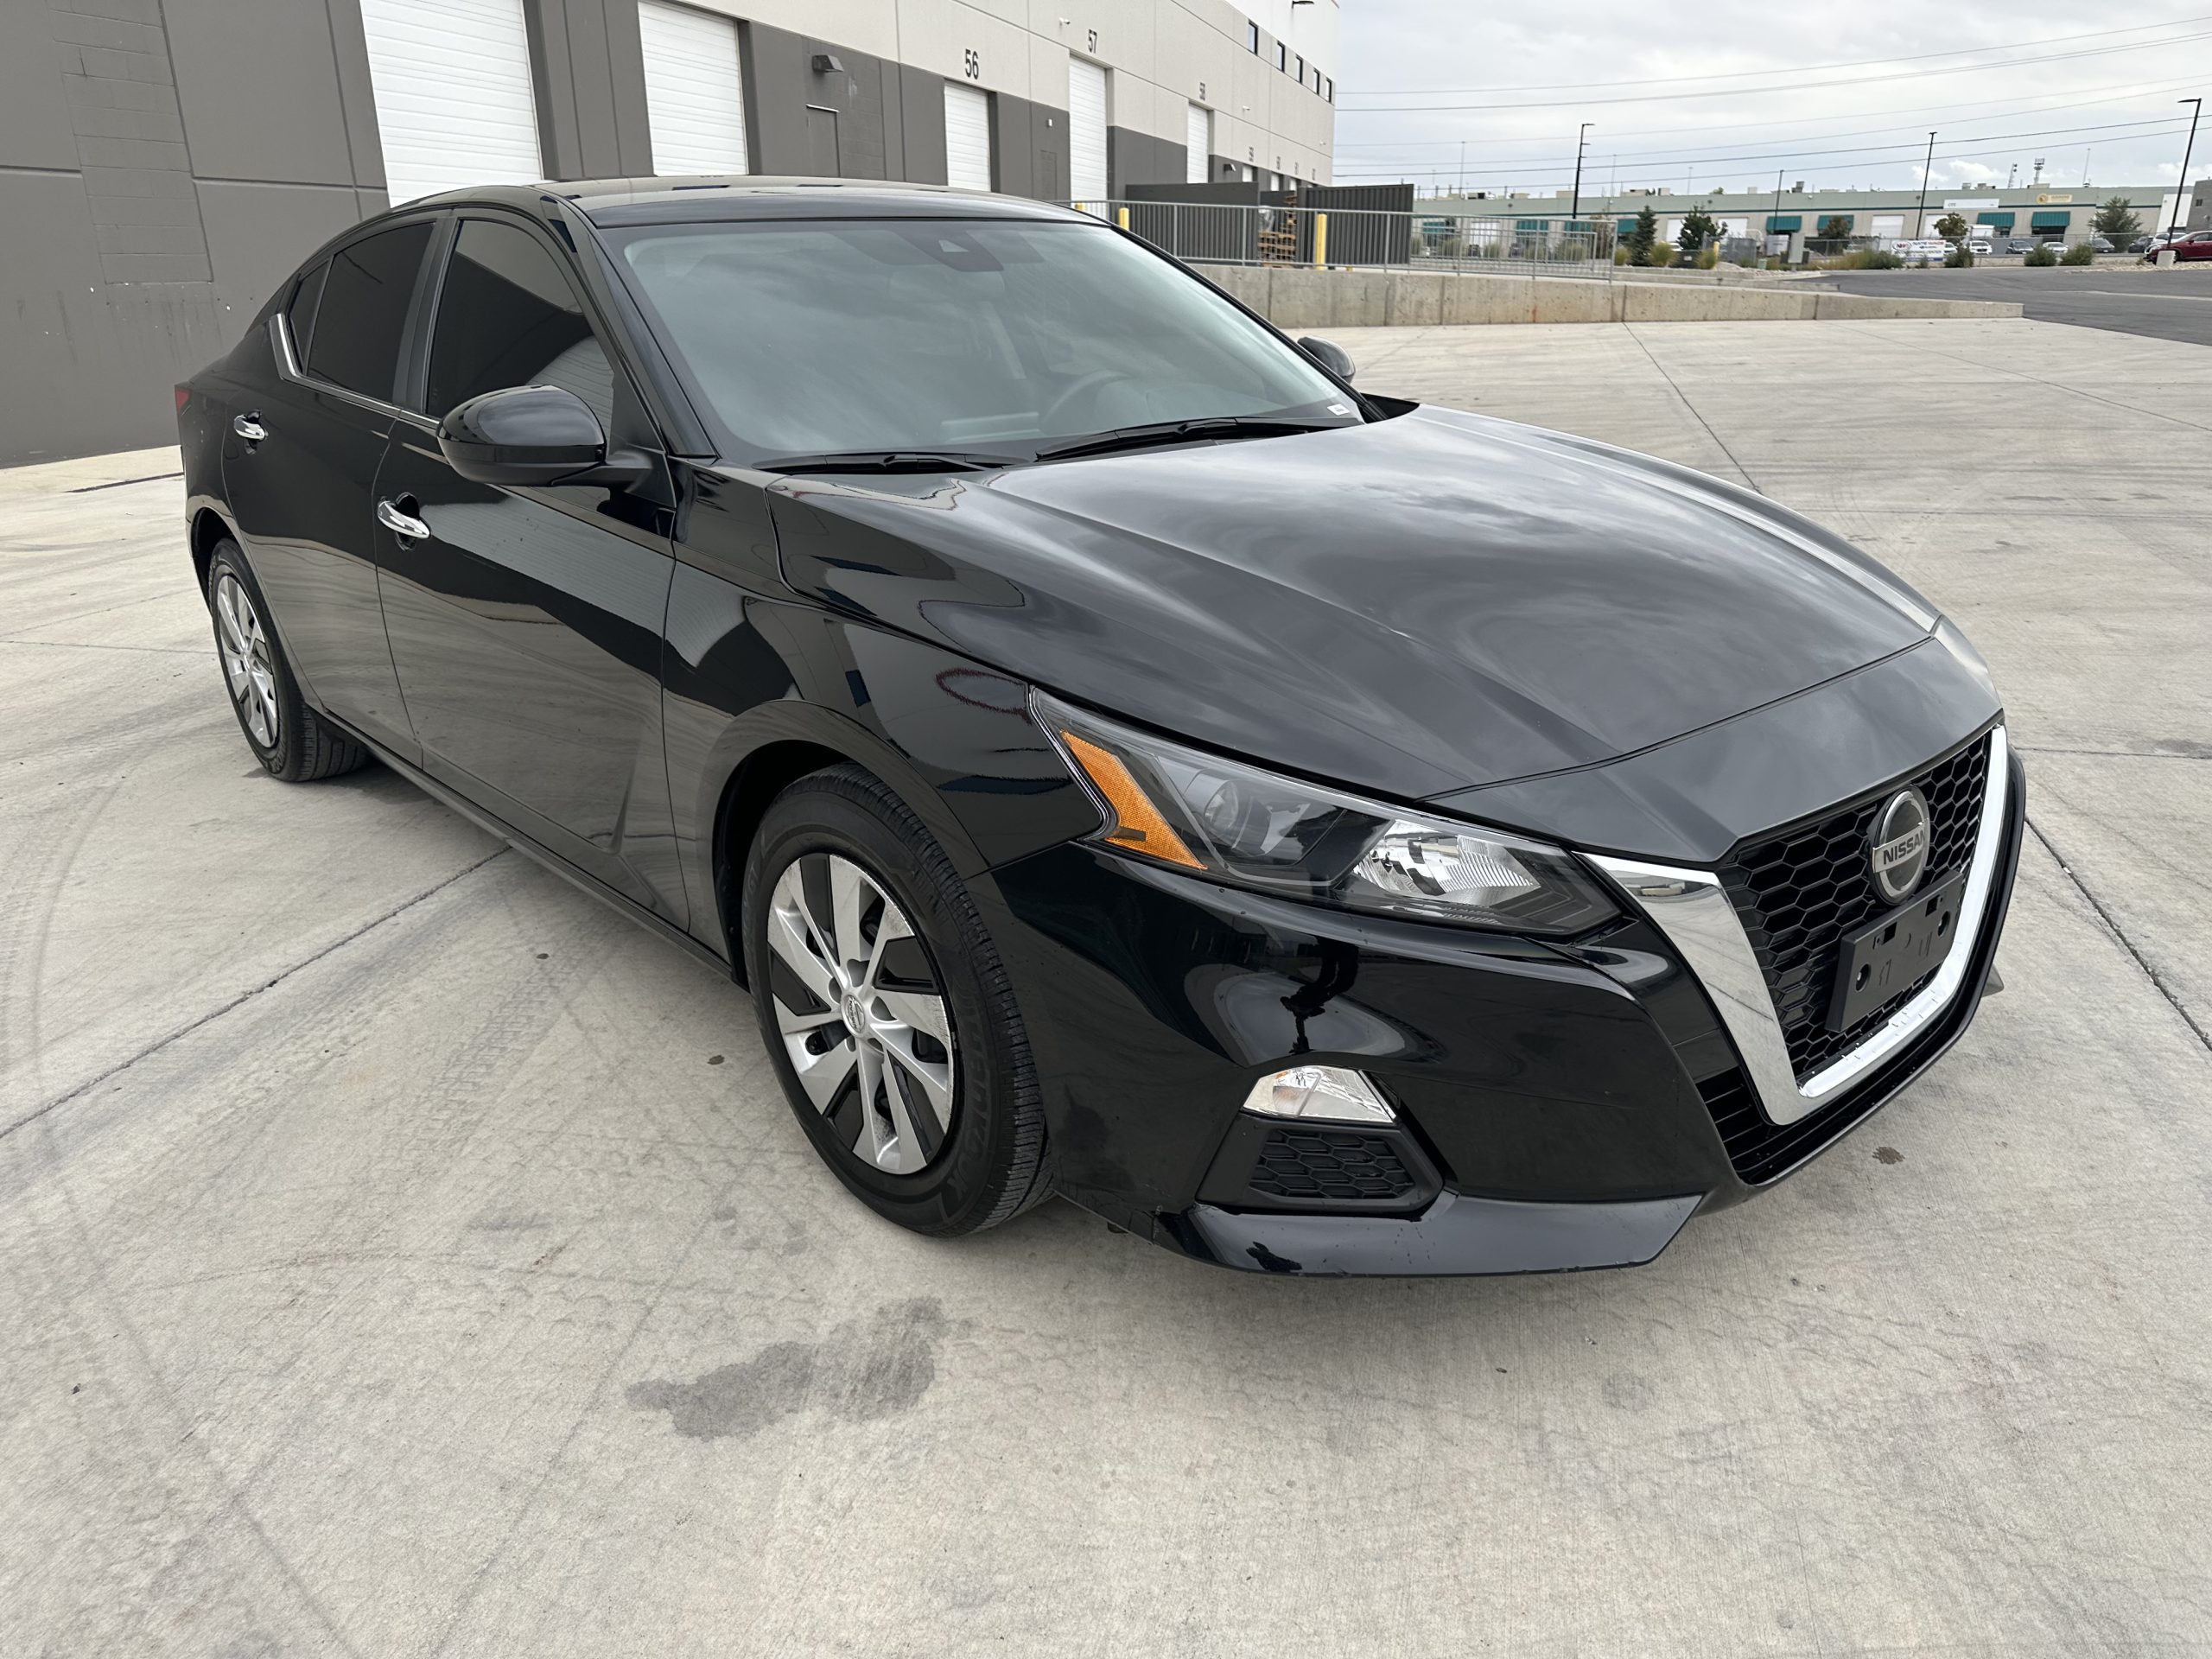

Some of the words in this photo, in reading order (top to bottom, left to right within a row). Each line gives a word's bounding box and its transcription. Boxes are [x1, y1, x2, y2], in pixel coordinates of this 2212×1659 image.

[1088, 29, 1097, 54] 57
[965, 48, 979, 79] 56
[1884, 830, 1925, 865] NISSAN
